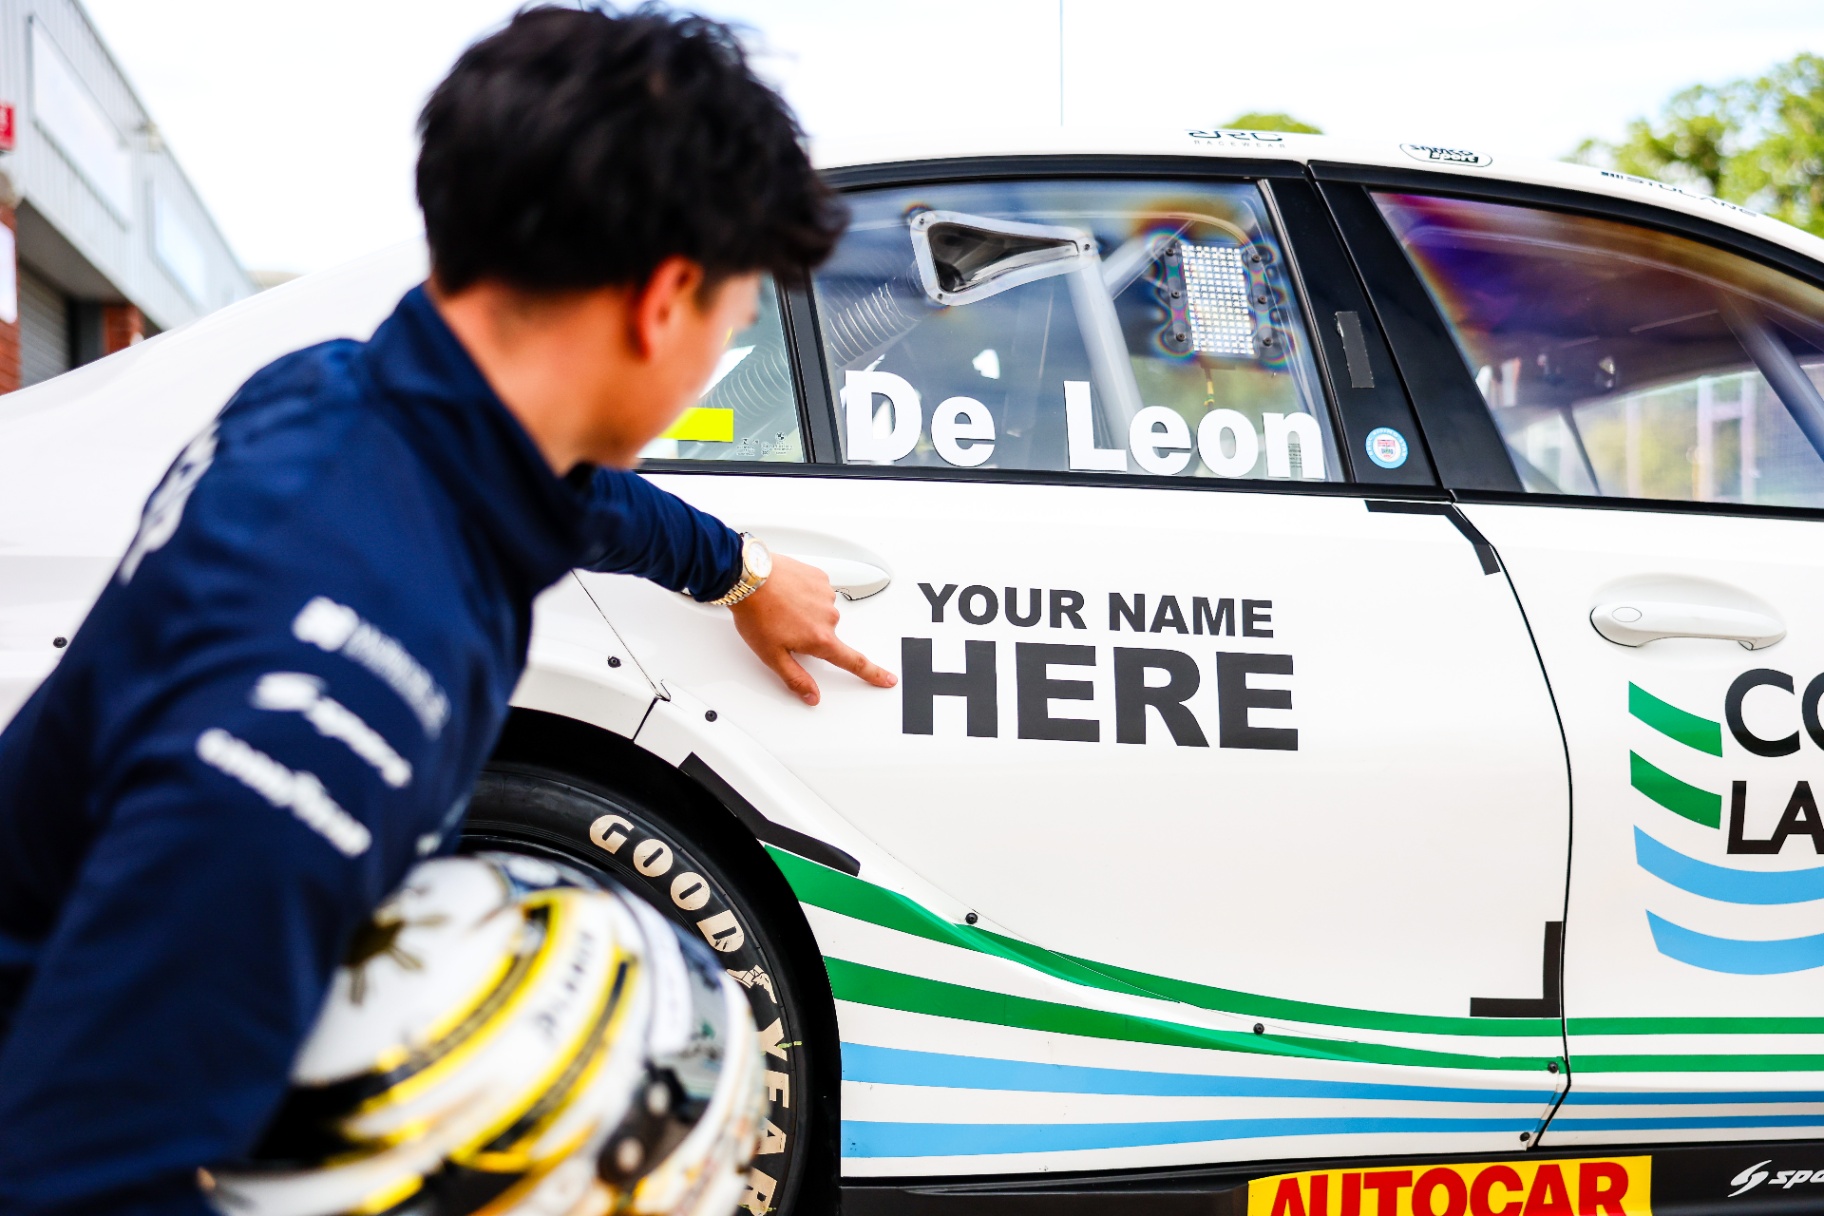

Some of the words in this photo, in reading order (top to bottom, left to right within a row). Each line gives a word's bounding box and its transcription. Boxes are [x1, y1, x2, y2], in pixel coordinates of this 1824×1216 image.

[843, 370, 996, 468] De
[1063, 380, 1326, 479] Leon
[918, 582, 1087, 630] YOUR
[1108, 592, 1274, 639] NAME
[901, 637, 1299, 752] HERE
[1271, 1161, 1629, 1216] AUTOCAR
